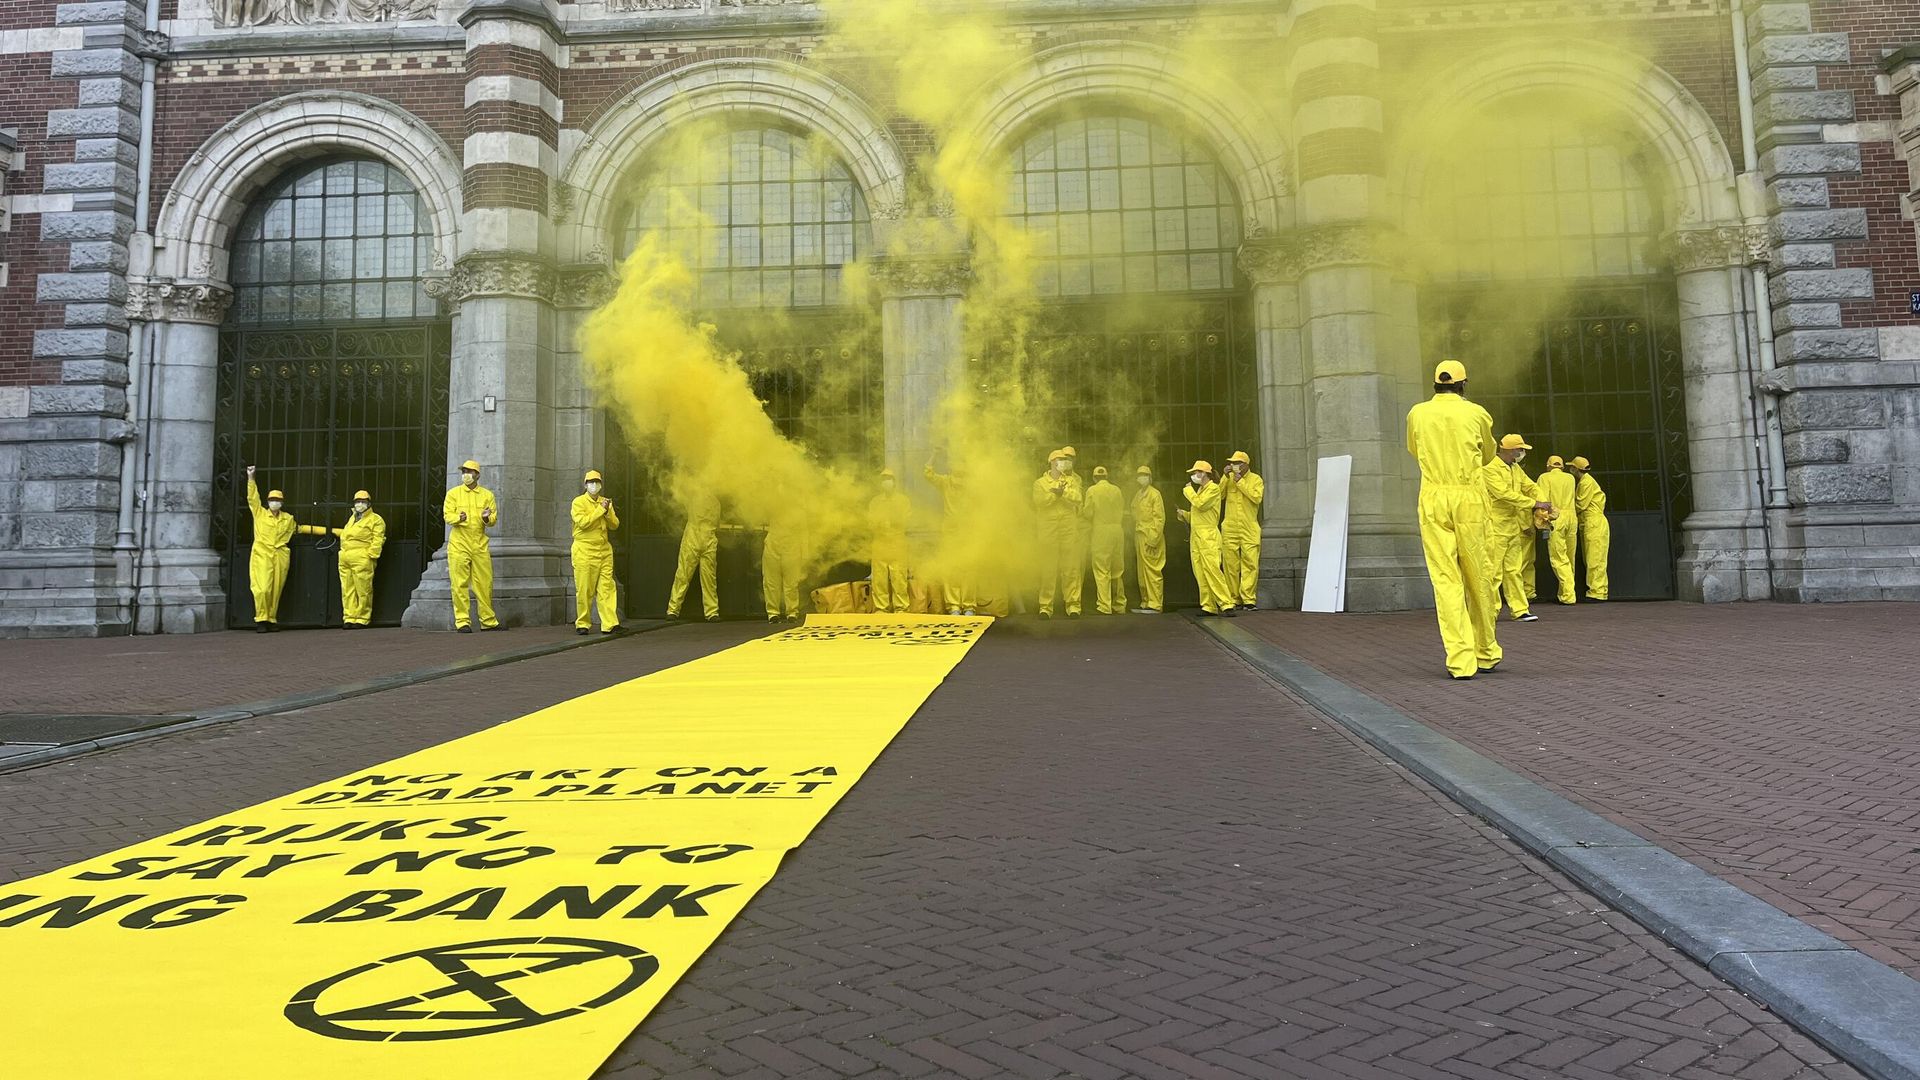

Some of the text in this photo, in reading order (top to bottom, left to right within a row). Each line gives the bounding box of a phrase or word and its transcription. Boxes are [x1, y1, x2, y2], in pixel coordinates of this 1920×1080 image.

[343, 766, 838, 787] NO ART ON A
[297, 781, 833, 804] DEAD PLANET
[167, 816, 527, 847] RIJKS,
[69, 843, 754, 881] SAY NO TO
[292, 884, 741, 924] BANK
